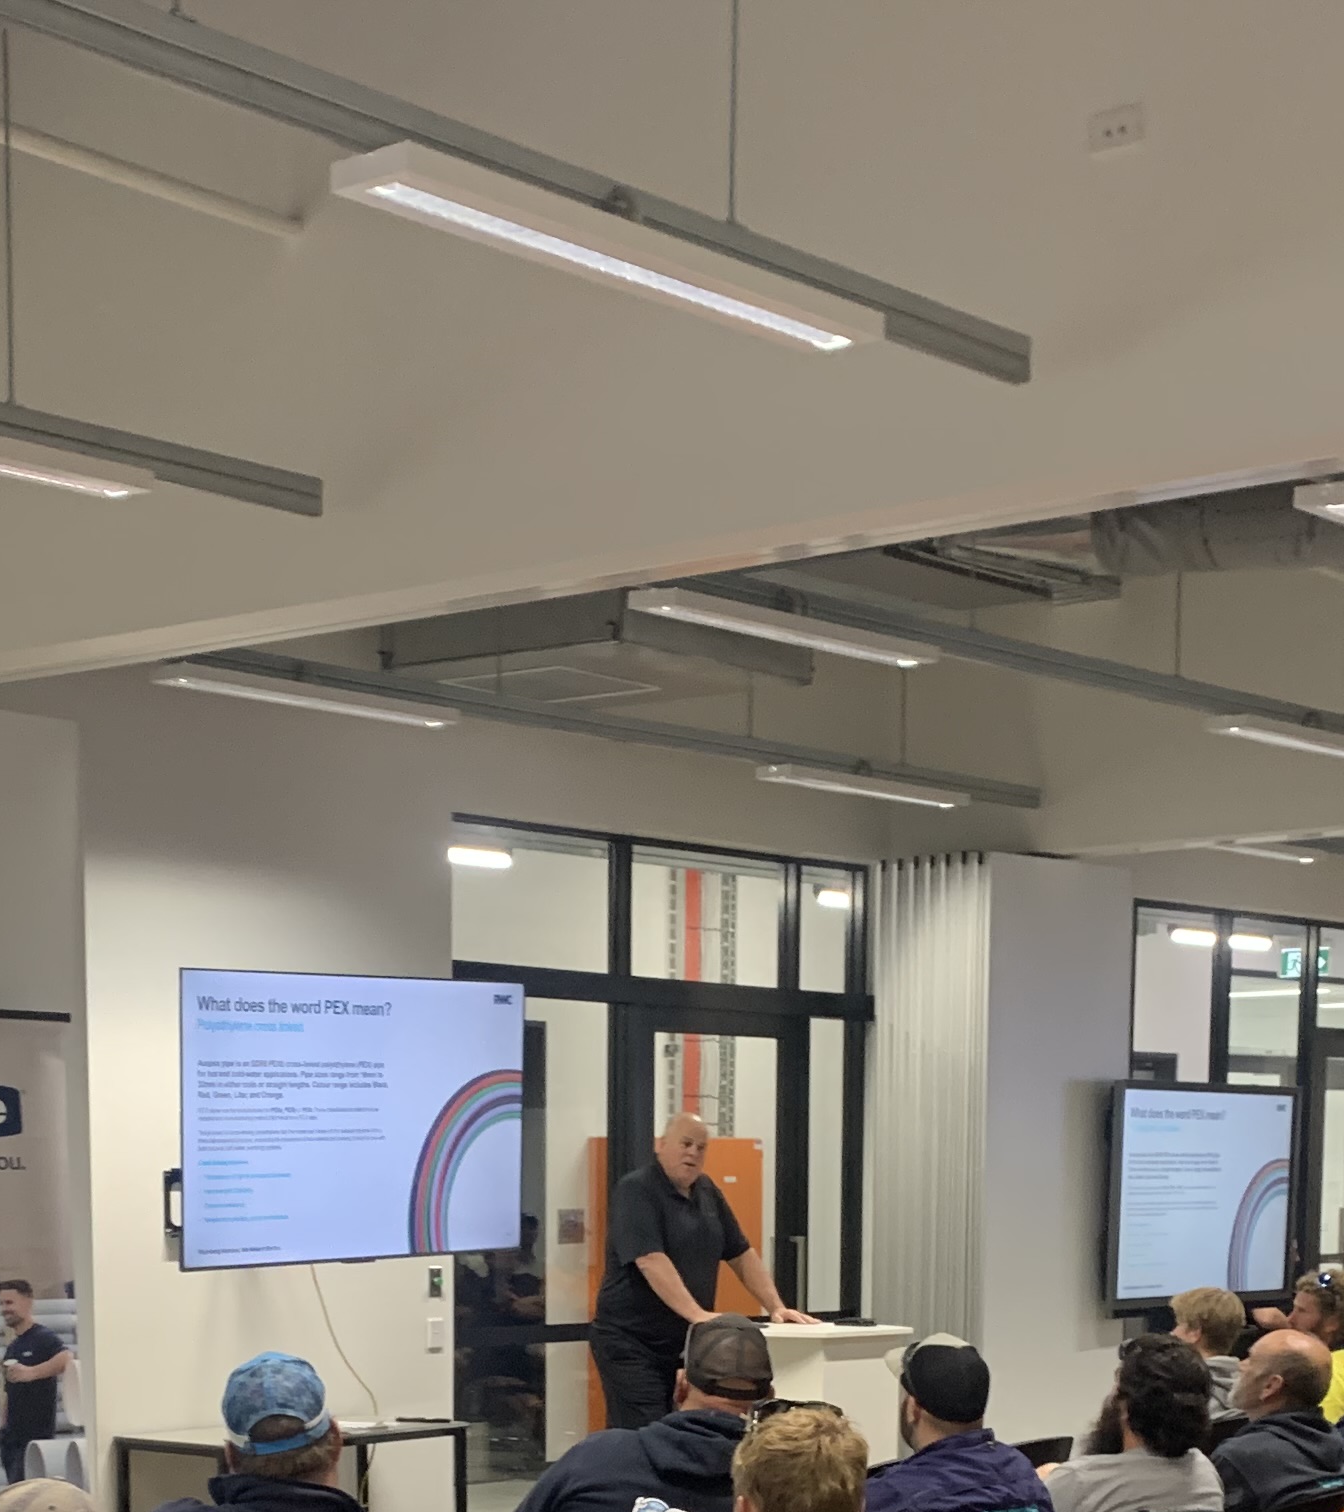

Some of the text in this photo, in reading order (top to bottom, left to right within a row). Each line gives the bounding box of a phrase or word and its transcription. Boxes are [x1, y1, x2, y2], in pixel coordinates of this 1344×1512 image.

[196, 995, 392, 1017] What does the word PEX mean?
